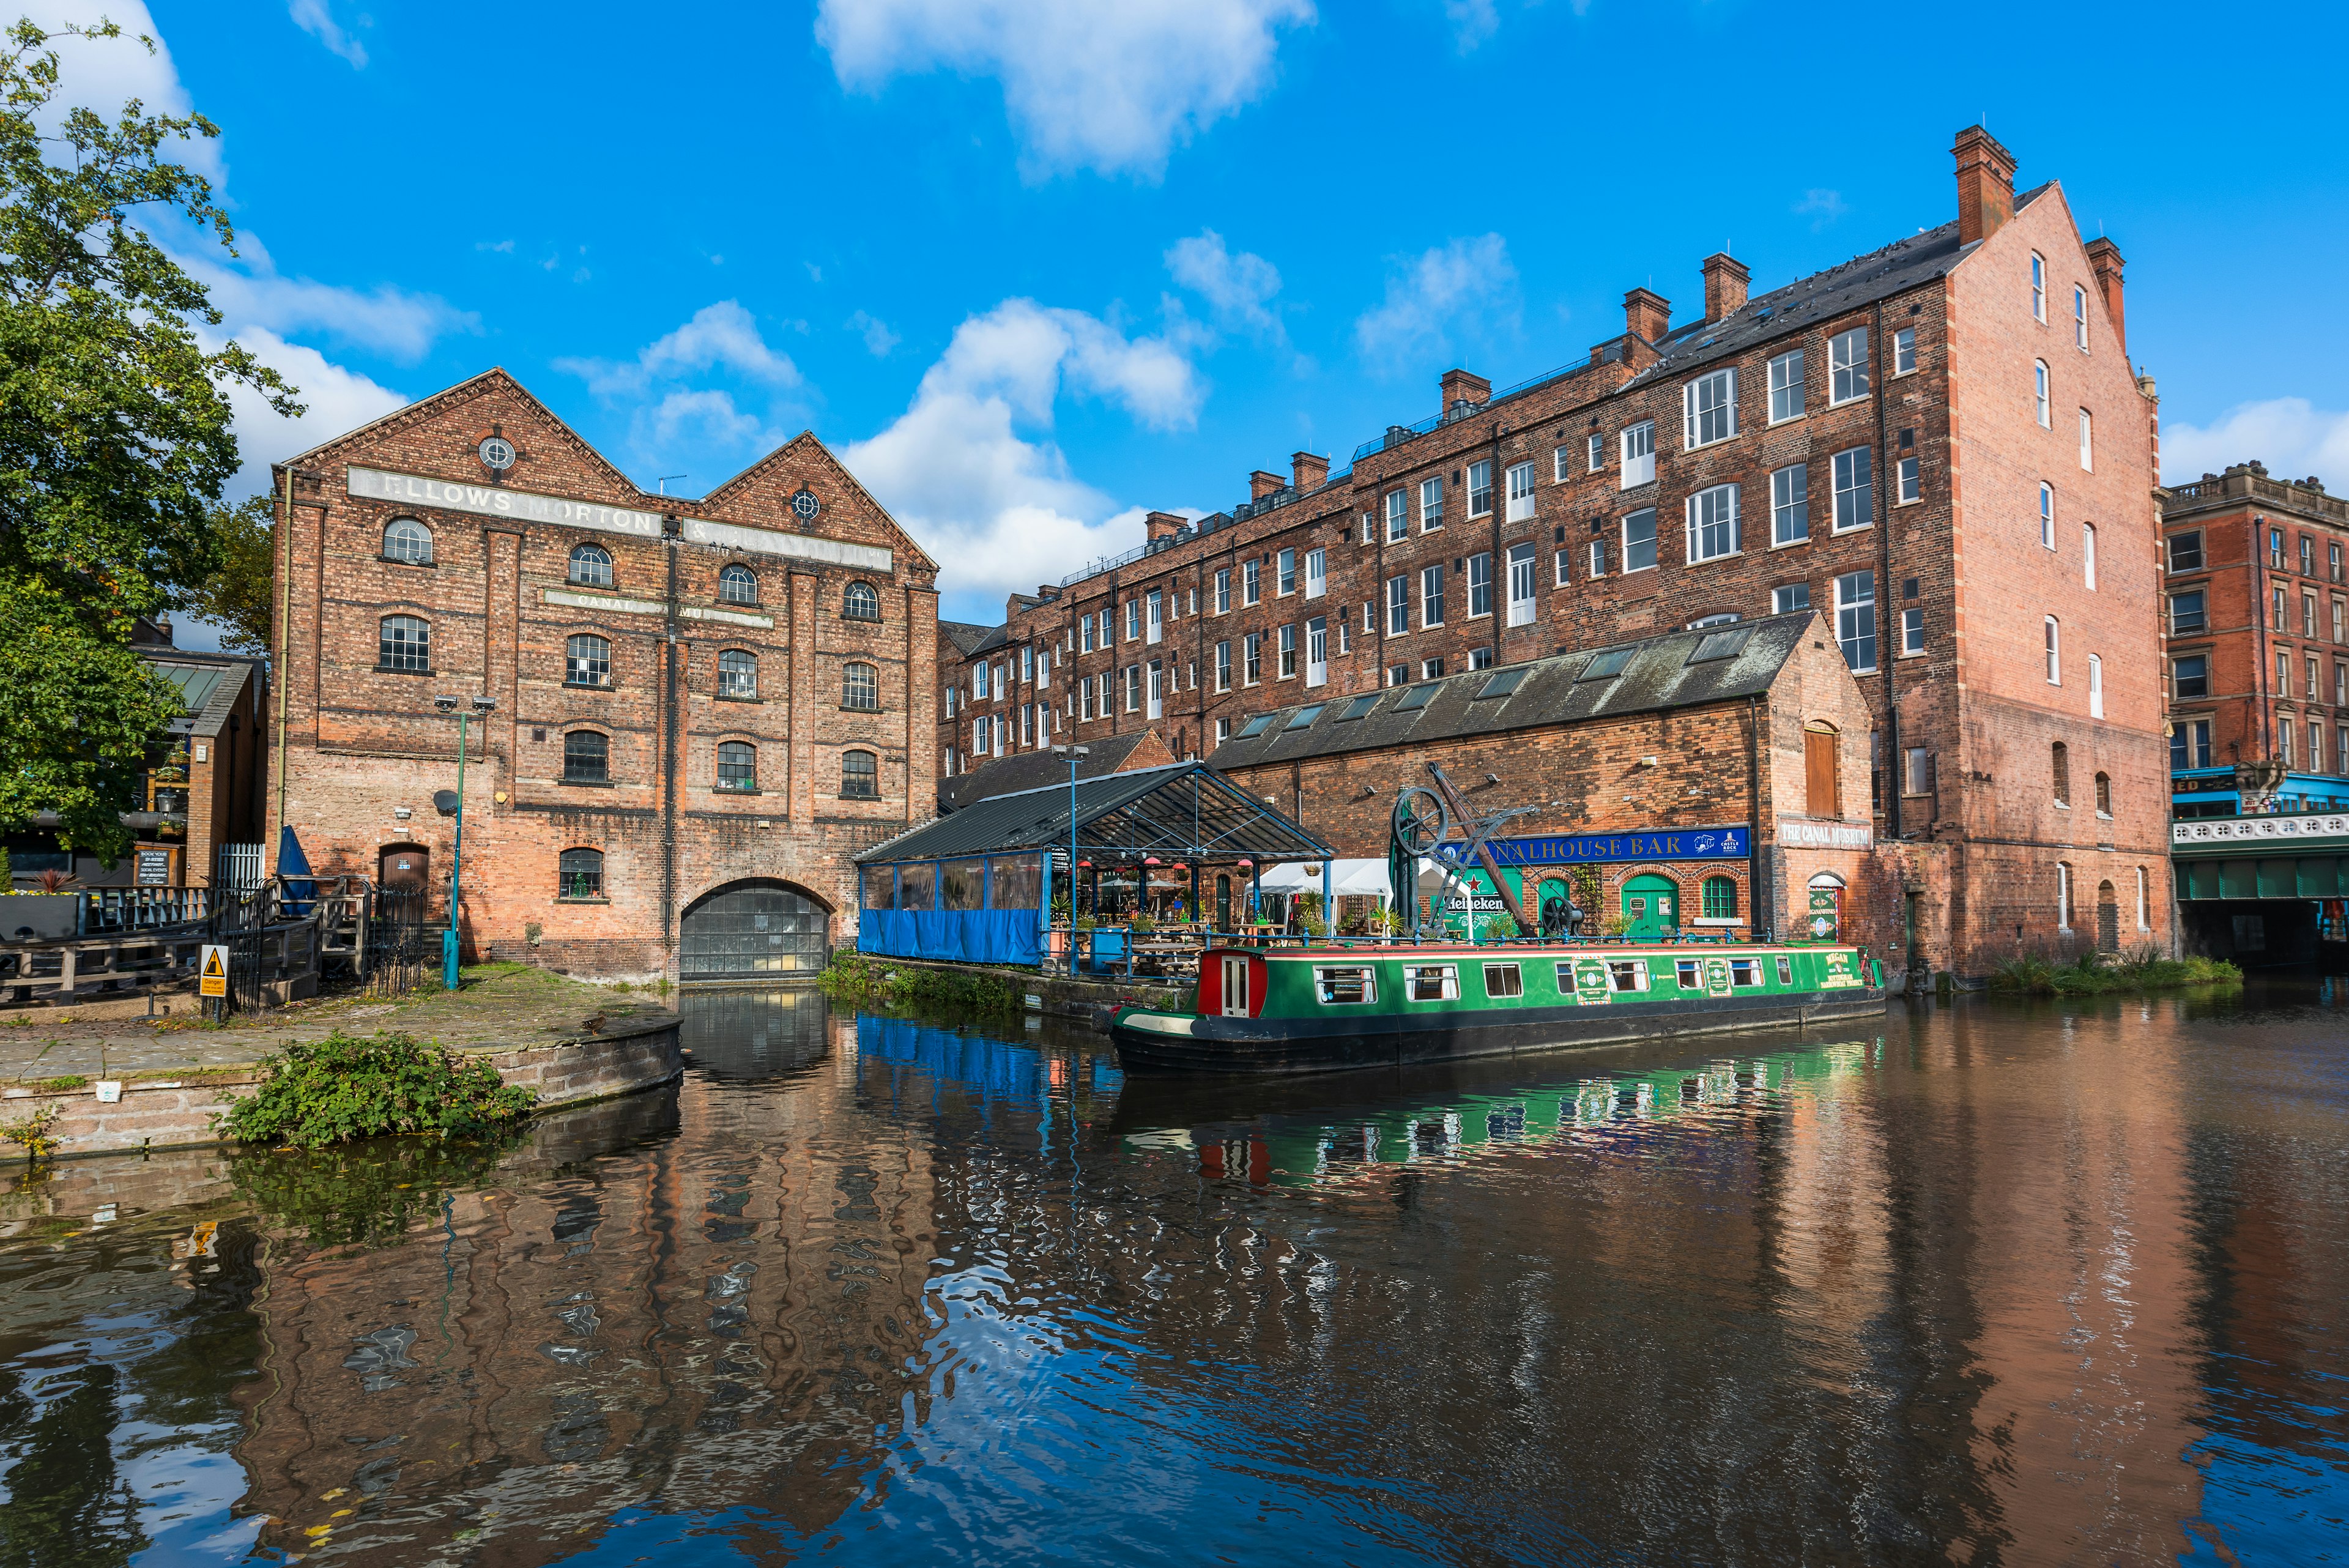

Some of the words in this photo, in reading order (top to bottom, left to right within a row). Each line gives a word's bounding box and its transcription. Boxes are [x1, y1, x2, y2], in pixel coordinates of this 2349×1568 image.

[385, 475, 511, 511] ELLOWS
[692, 522, 706, 540] &
[577, 595, 633, 611] CANAL
[1781, 824, 1800, 841] THE
[1802, 825, 1830, 844] CANAL
[1831, 827, 1868, 844] MUSEUM
[1466, 839, 1621, 861] NALHOUSE
[1630, 837, 1682, 855] BAR
[1825, 953, 1848, 965] MEGAN
